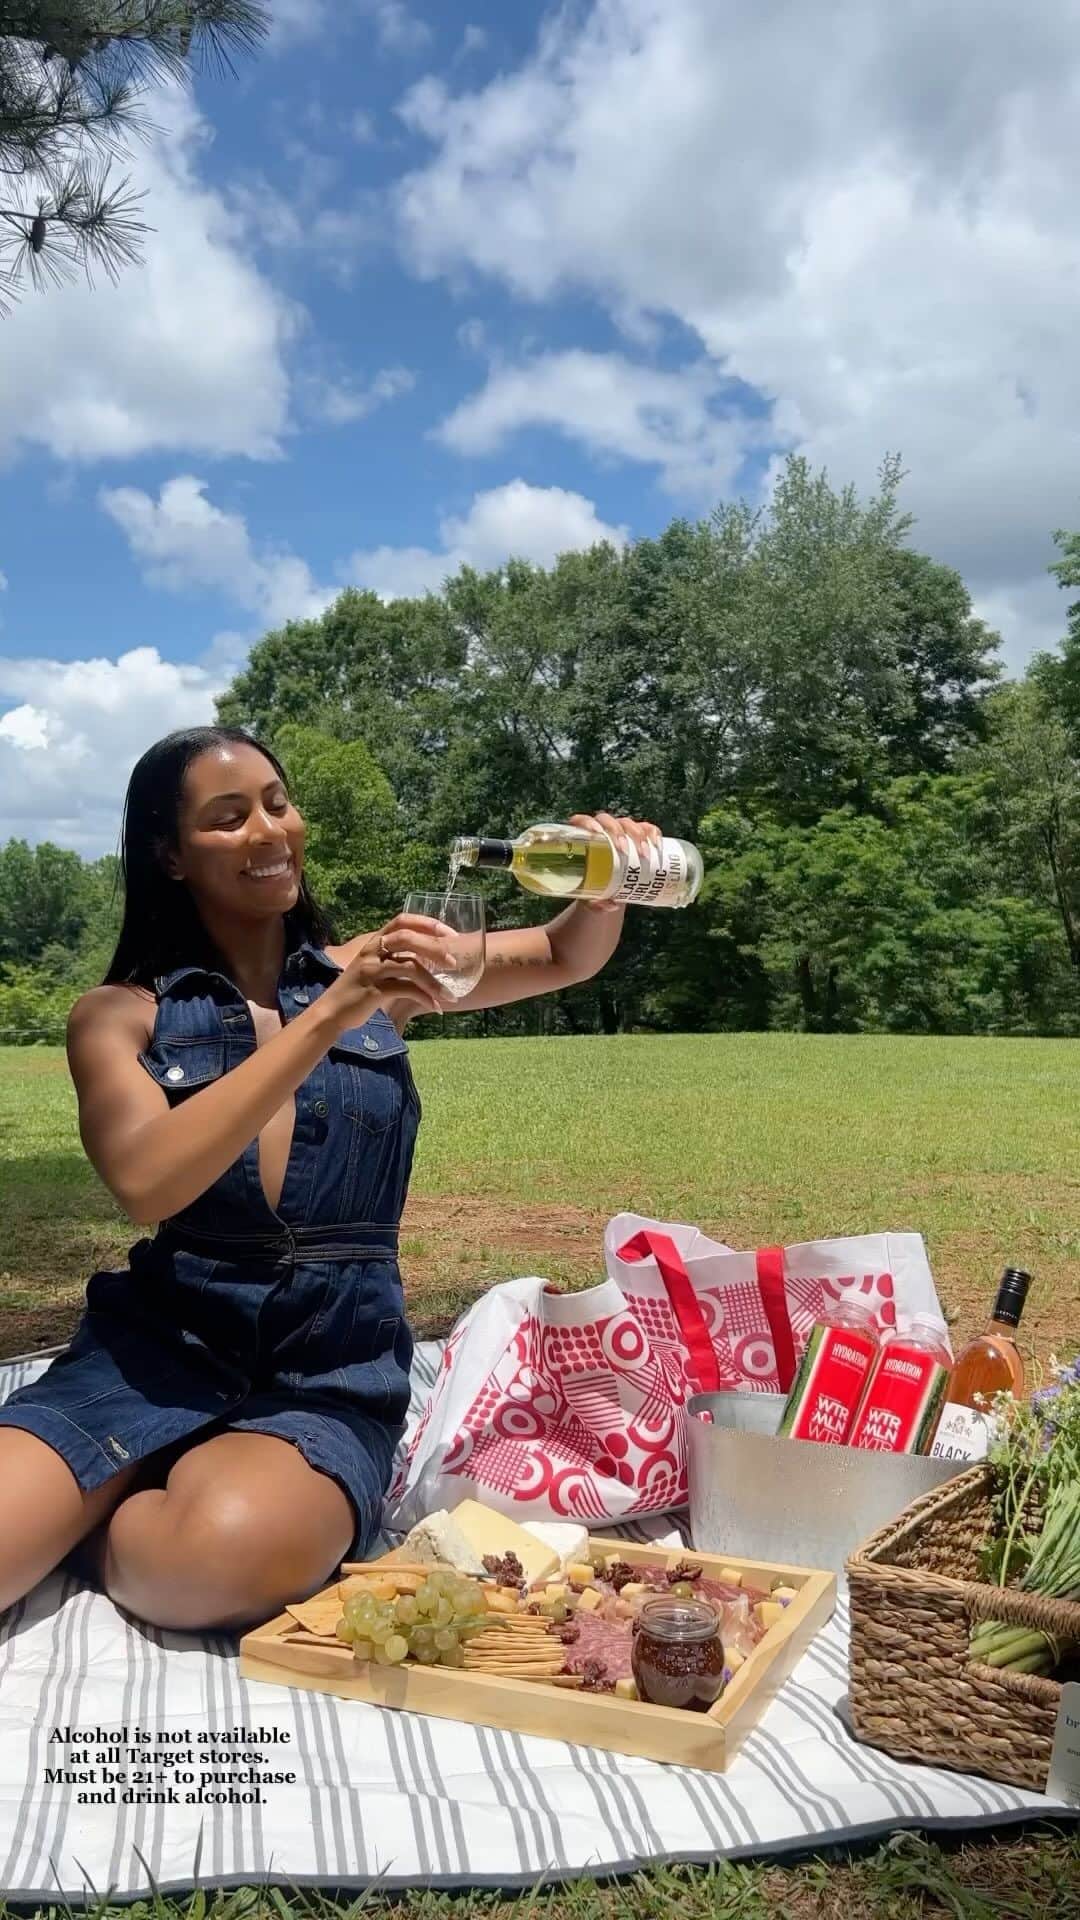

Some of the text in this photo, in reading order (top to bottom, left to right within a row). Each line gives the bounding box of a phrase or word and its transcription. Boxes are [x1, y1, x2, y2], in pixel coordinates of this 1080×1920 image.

[615, 866, 641, 900] BLACK
[641, 869, 667, 902] MAGIC
[832, 1343, 868, 1371] HYDRATION
[883, 1357, 923, 1380] HYDRATION
[817, 1395, 849, 1421] WTR
[868, 1408, 902, 1430] WTR
[811, 1410, 846, 1435] MLN
[862, 1421, 898, 1444] MLN
[933, 1441, 972, 1460] BLACK
